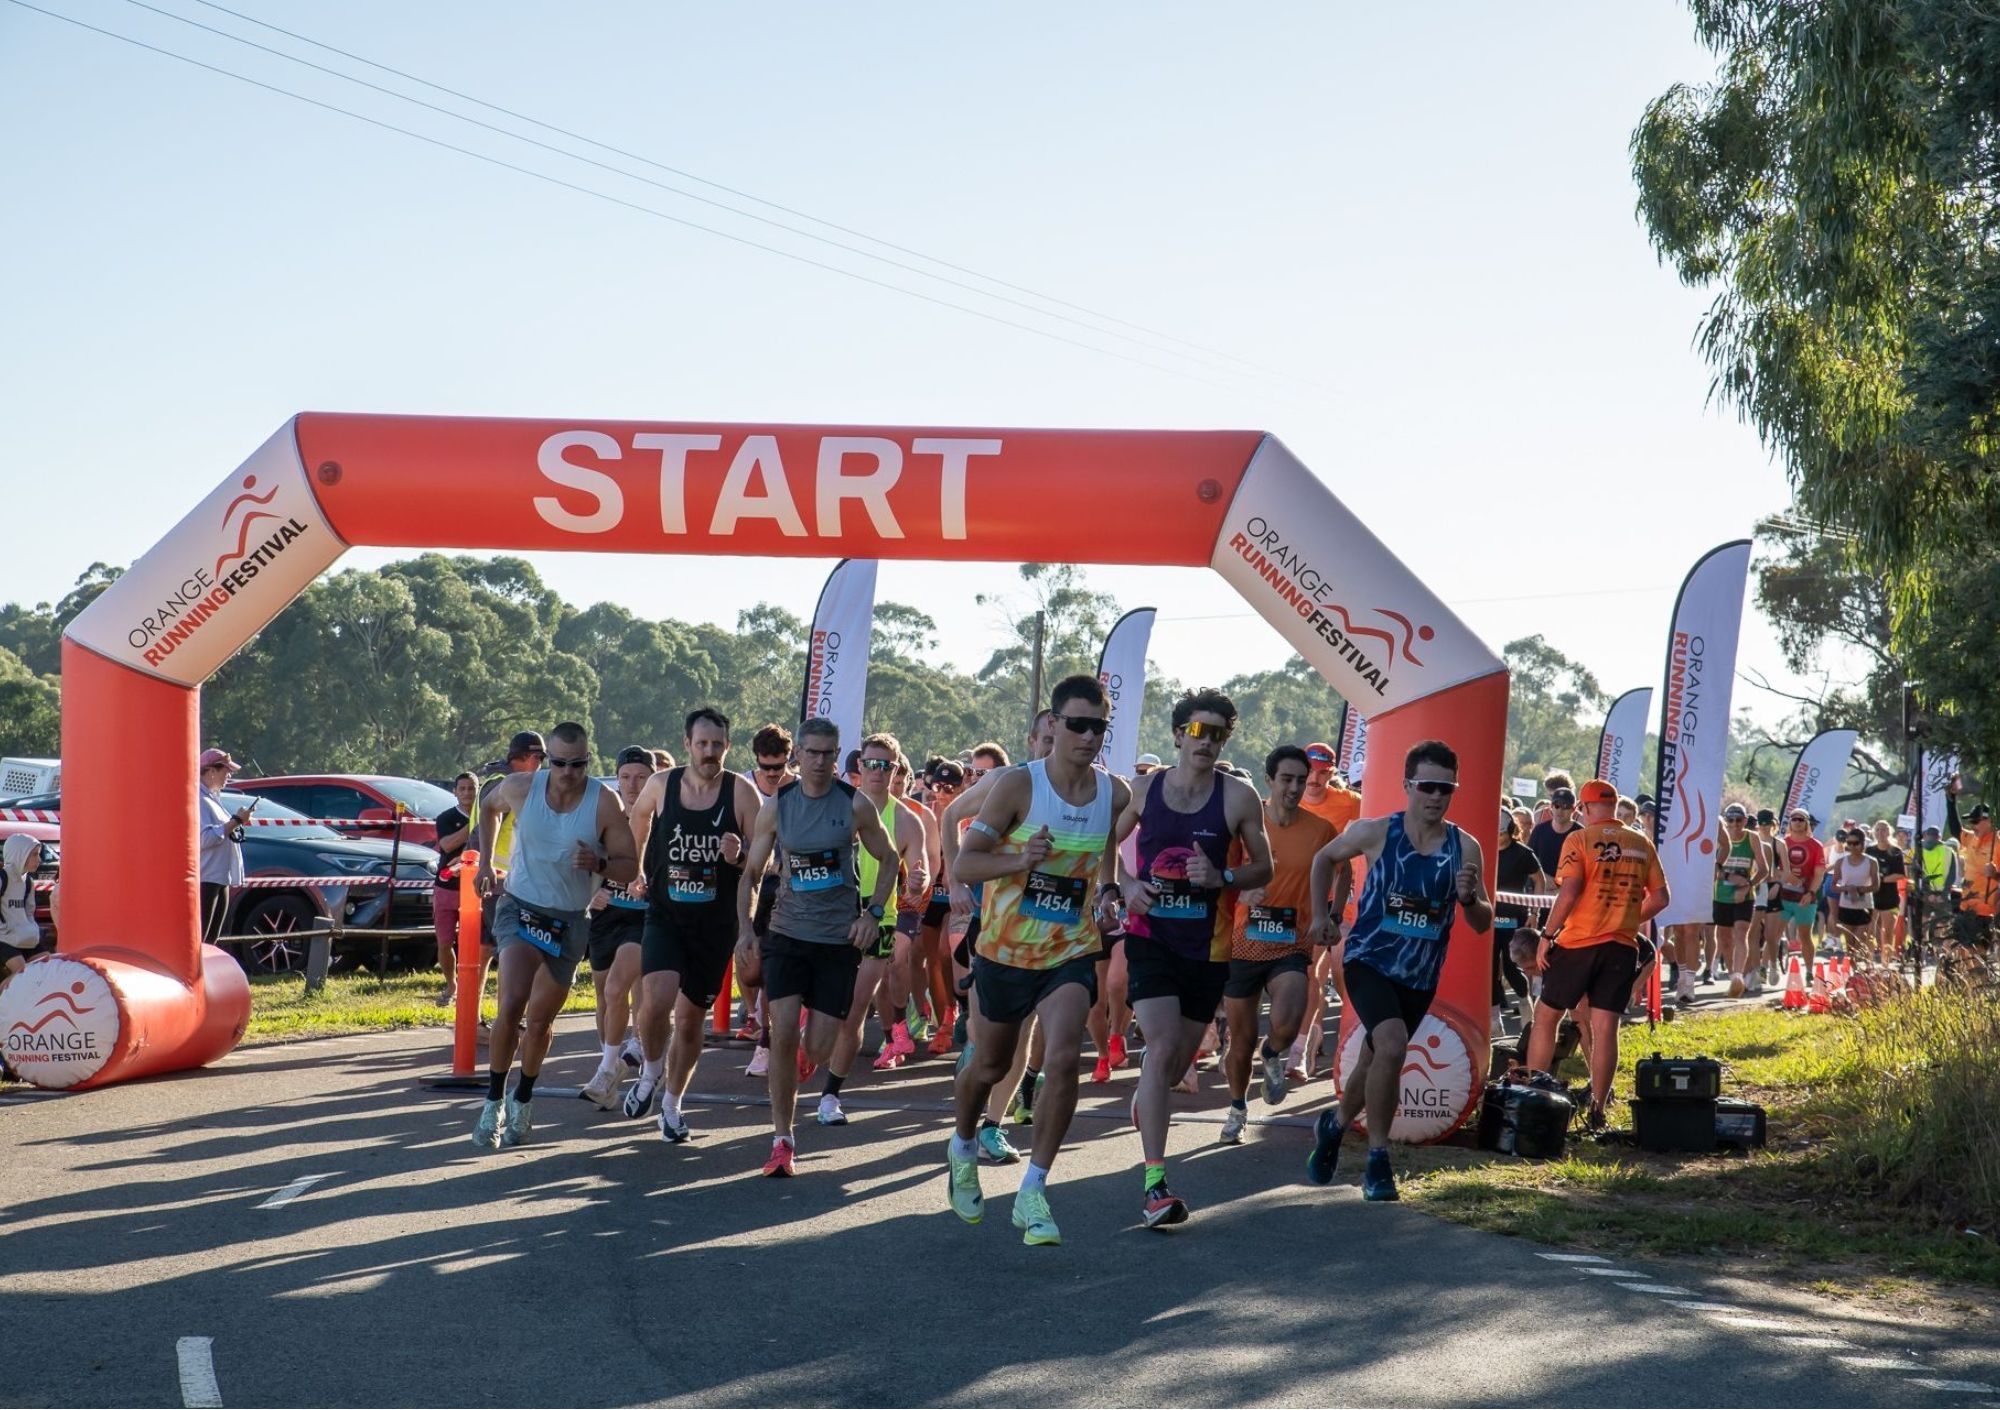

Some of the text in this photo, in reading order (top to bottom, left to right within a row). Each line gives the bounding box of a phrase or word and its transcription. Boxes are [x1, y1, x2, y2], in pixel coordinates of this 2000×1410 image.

[533, 429, 1003, 540] START
[1246, 516, 1334, 604] ORANGE
[128, 567, 215, 649] ORANGE
[819, 631, 842, 716] ORANG
[1681, 635, 1705, 747] ORANGE
[668, 847, 720, 862] crew
[798, 866, 829, 883] 1453
[1029, 878, 1045, 889] 20
[674, 881, 705, 894] 1402
[1035, 892, 1072, 913] 1454
[1158, 894, 1191, 909] 1341
[1388, 896, 1404, 907] 20
[1258, 920, 1284, 933] 1186
[1397, 910, 1428, 929] 1518
[526, 923, 552, 945] 1600
[8, 1031, 97, 1052] ORANGE
[8, 1051, 101, 1063] RUNNING FESTIVAL
[1399, 1087, 1451, 1107] NGE
[1403, 1108, 1453, 1118] FESTIVAL
